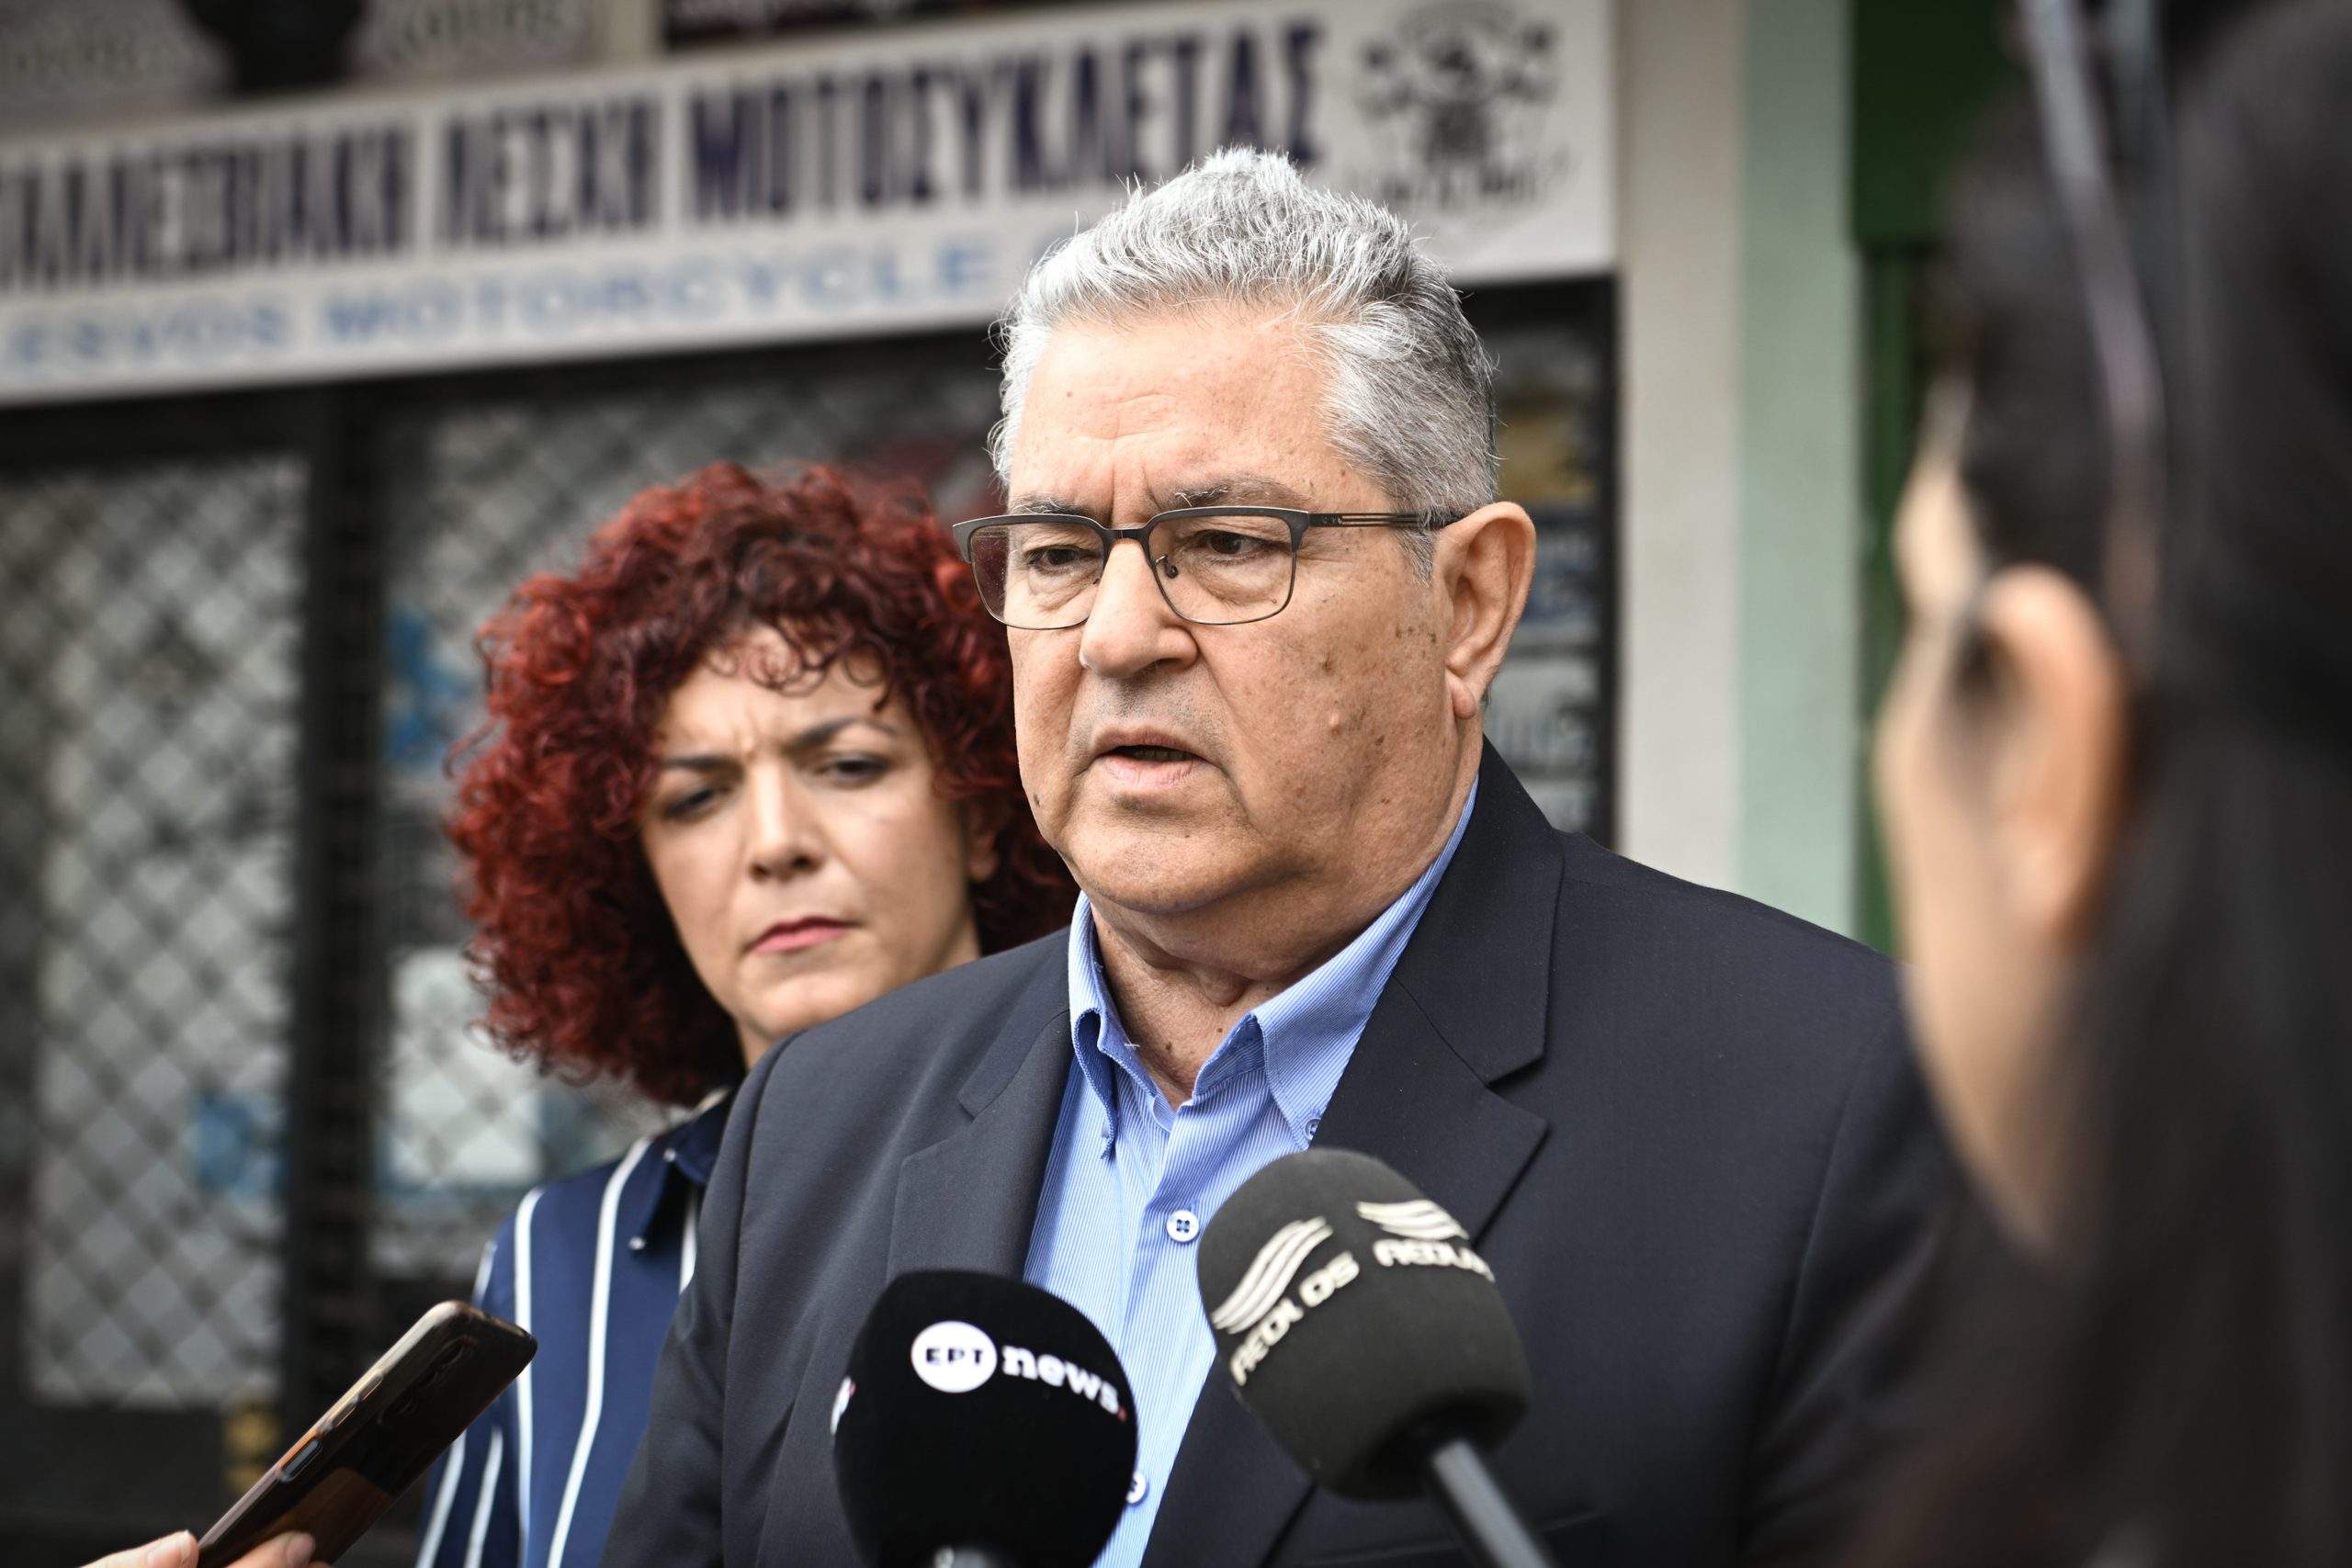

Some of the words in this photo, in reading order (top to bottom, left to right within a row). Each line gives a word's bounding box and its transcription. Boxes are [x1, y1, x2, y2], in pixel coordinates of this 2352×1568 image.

[2, 301, 290, 375] ESVOS
[323, 230, 1001, 347] MOTORCYCLE
[926, 1347, 984, 1367] ΕΡΤ
